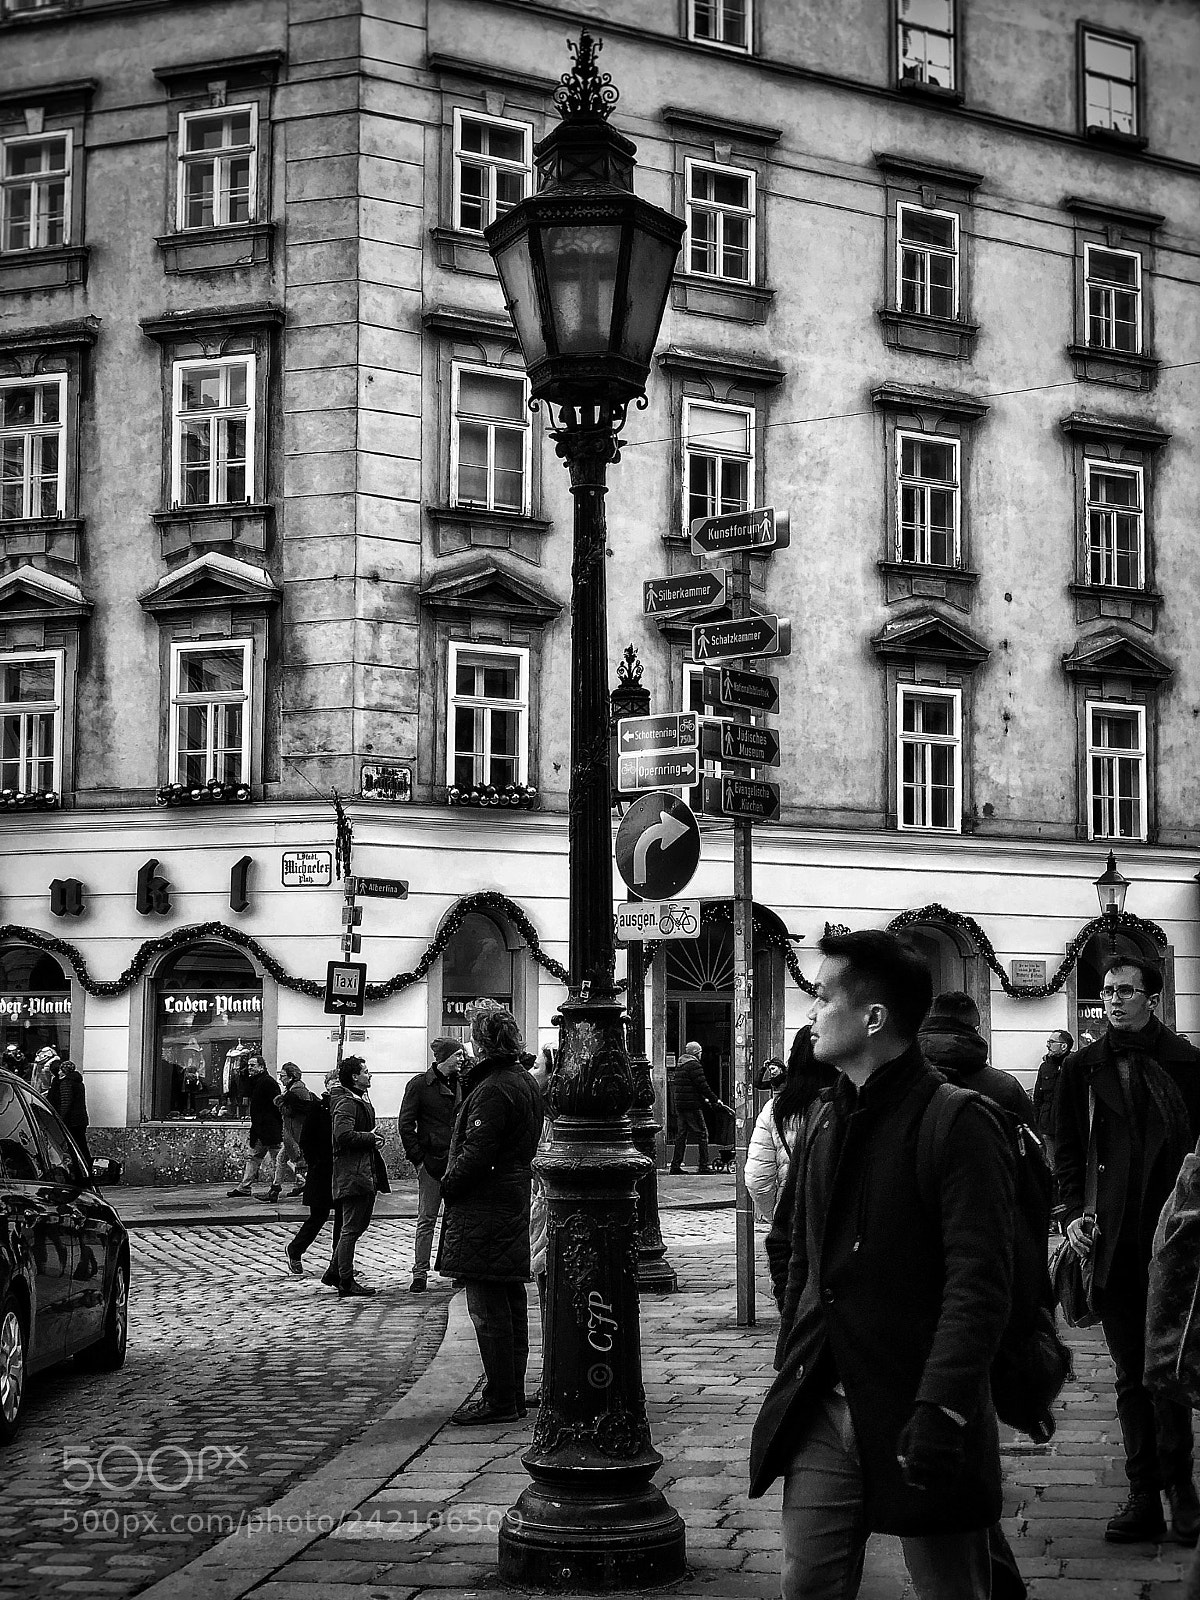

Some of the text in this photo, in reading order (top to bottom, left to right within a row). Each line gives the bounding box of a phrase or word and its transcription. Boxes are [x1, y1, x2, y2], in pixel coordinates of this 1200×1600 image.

[707, 522, 760, 541] Kunstforum
[658, 585, 711, 601] Silberkammer
[711, 630, 762, 646] Schatzkammer
[634, 728, 677, 741] Schottenring
[736, 726, 768, 746] Jüdisches
[738, 743, 765, 759] Museum
[638, 762, 681, 777] Opernring
[734, 781, 770, 799] Evangelische
[284, 860, 330, 875] Michaeler
[368, 883, 398, 893] Albertina
[619, 912, 658, 931] ausgen.
[335, 973, 358, 989] Taxi
